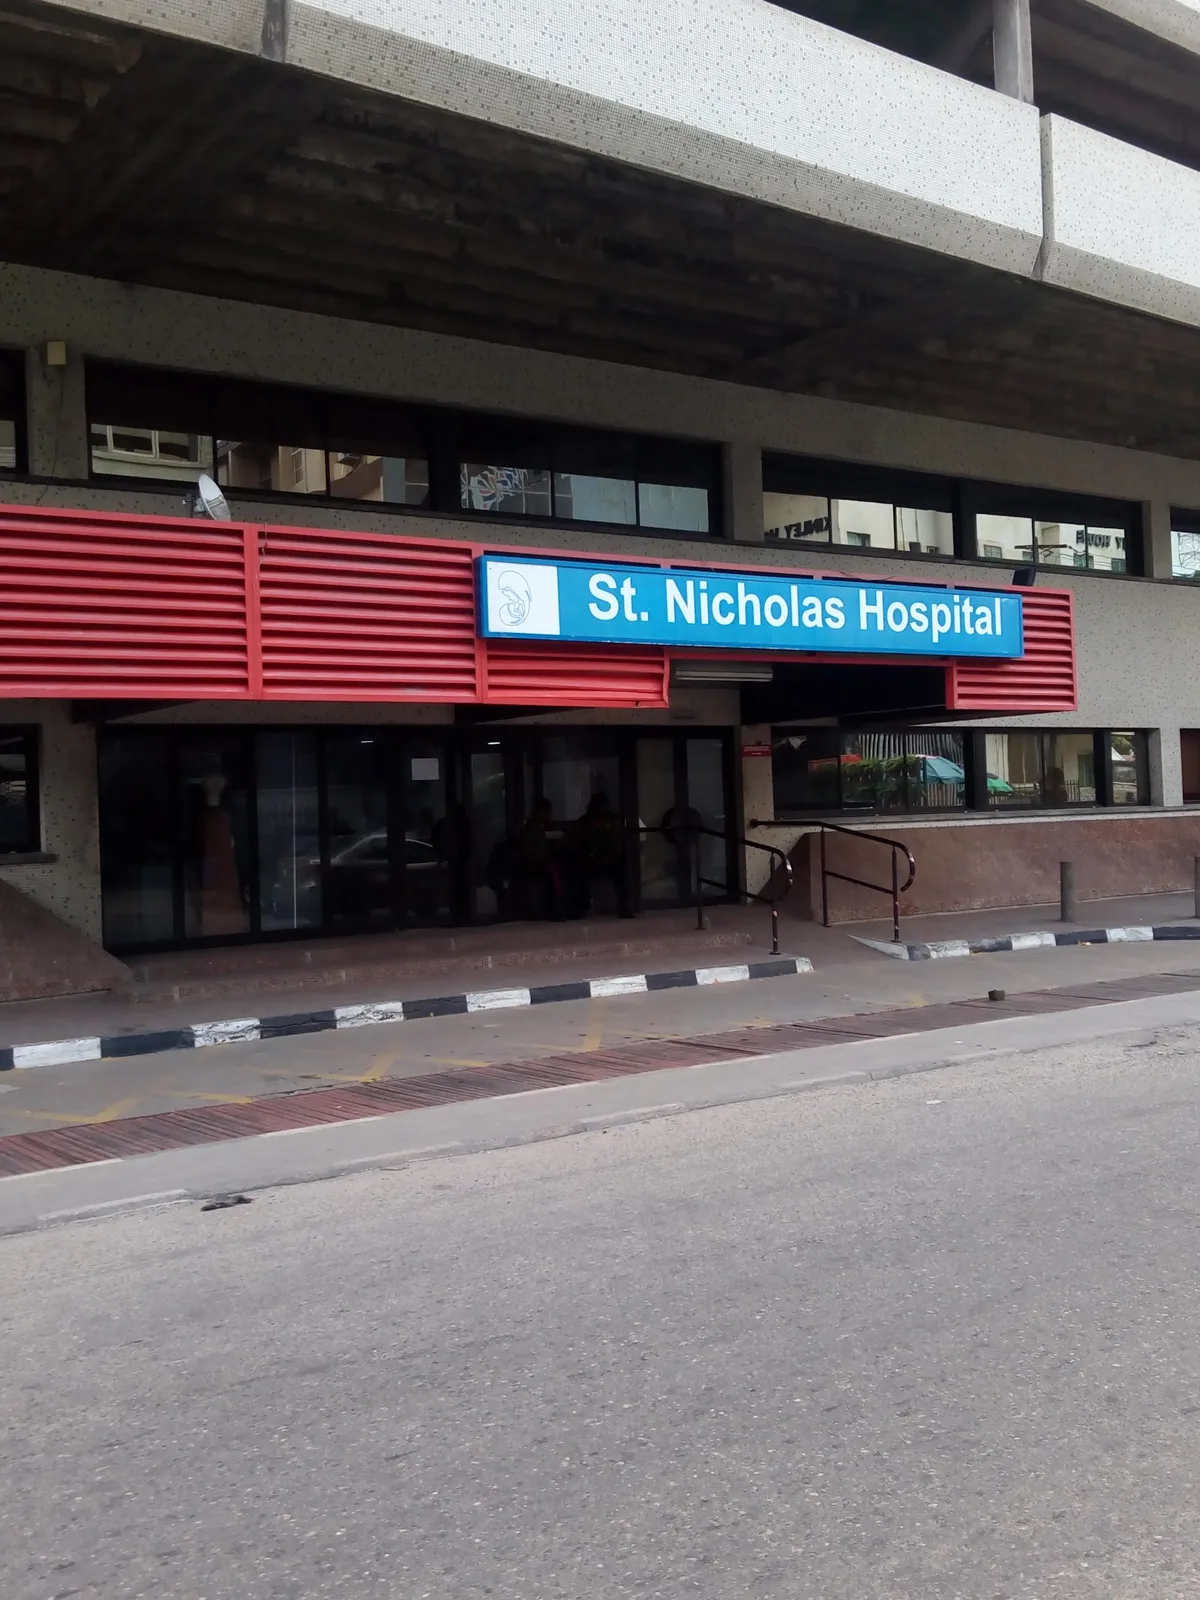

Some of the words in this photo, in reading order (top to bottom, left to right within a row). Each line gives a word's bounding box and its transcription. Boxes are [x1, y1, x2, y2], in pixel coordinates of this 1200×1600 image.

[588, 573, 649, 622] St.
[665, 578, 846, 629] Nicholas
[858, 588, 1002, 643] Hospital
